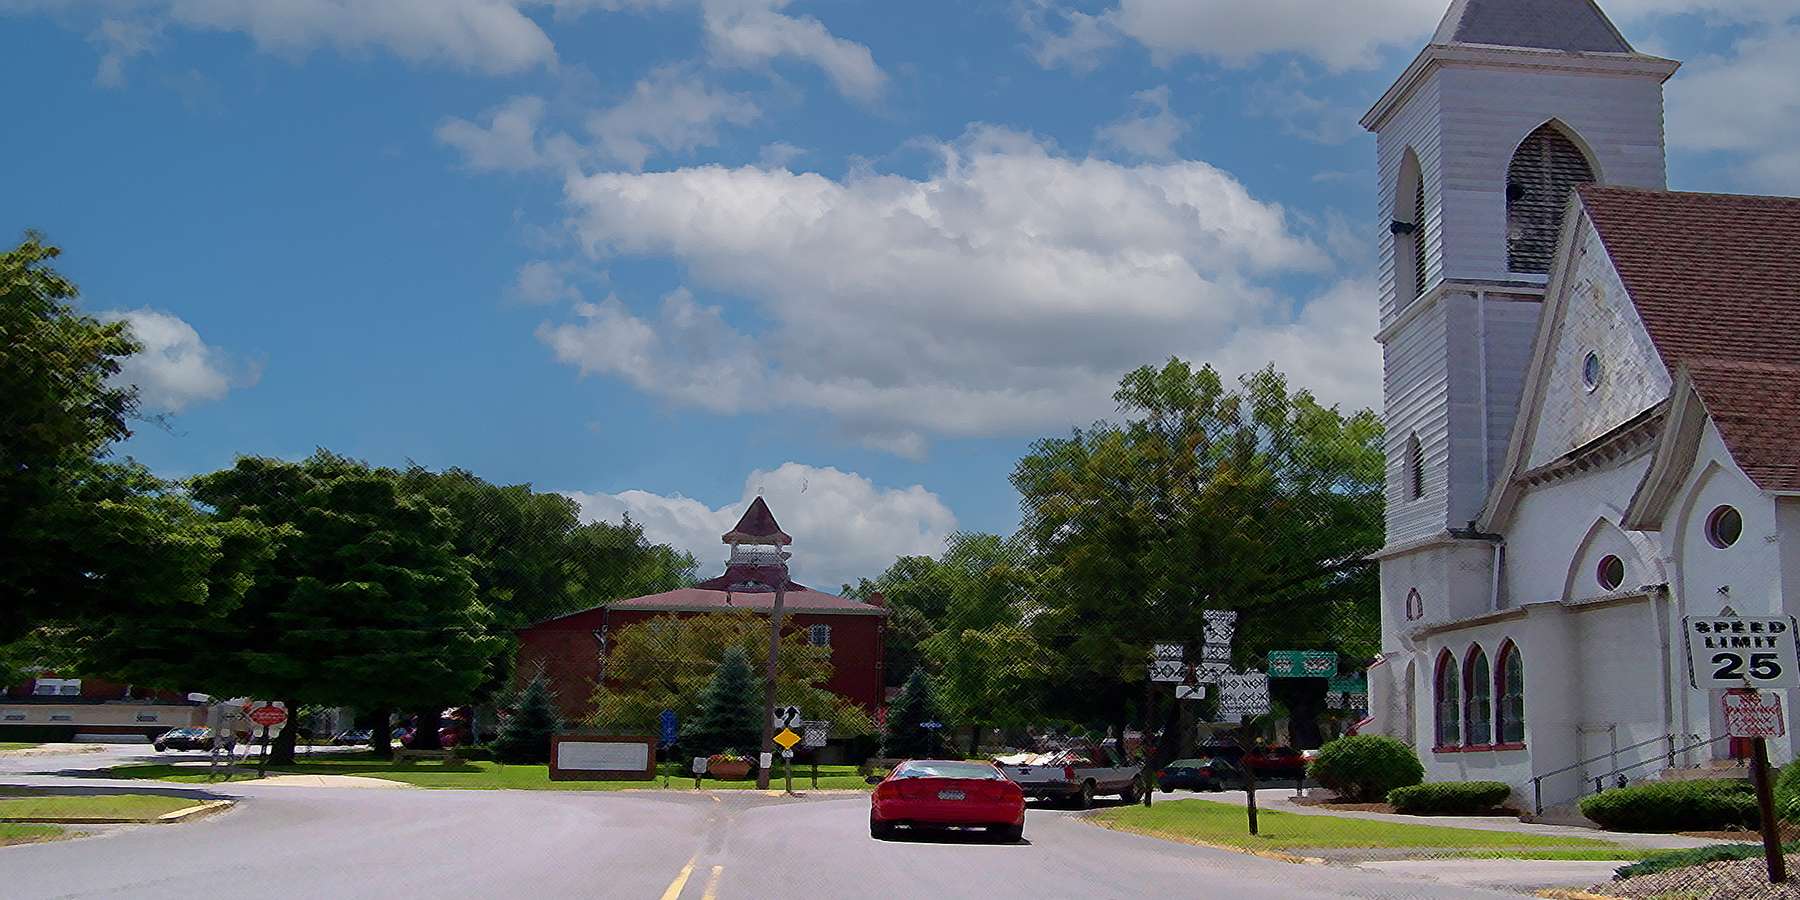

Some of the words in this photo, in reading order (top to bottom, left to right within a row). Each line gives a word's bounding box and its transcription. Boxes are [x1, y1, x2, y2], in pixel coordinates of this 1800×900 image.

[1694, 620, 1787, 634] SPEED
[1704, 636, 1778, 649] LIMIT
[1711, 652, 1783, 680] 25
